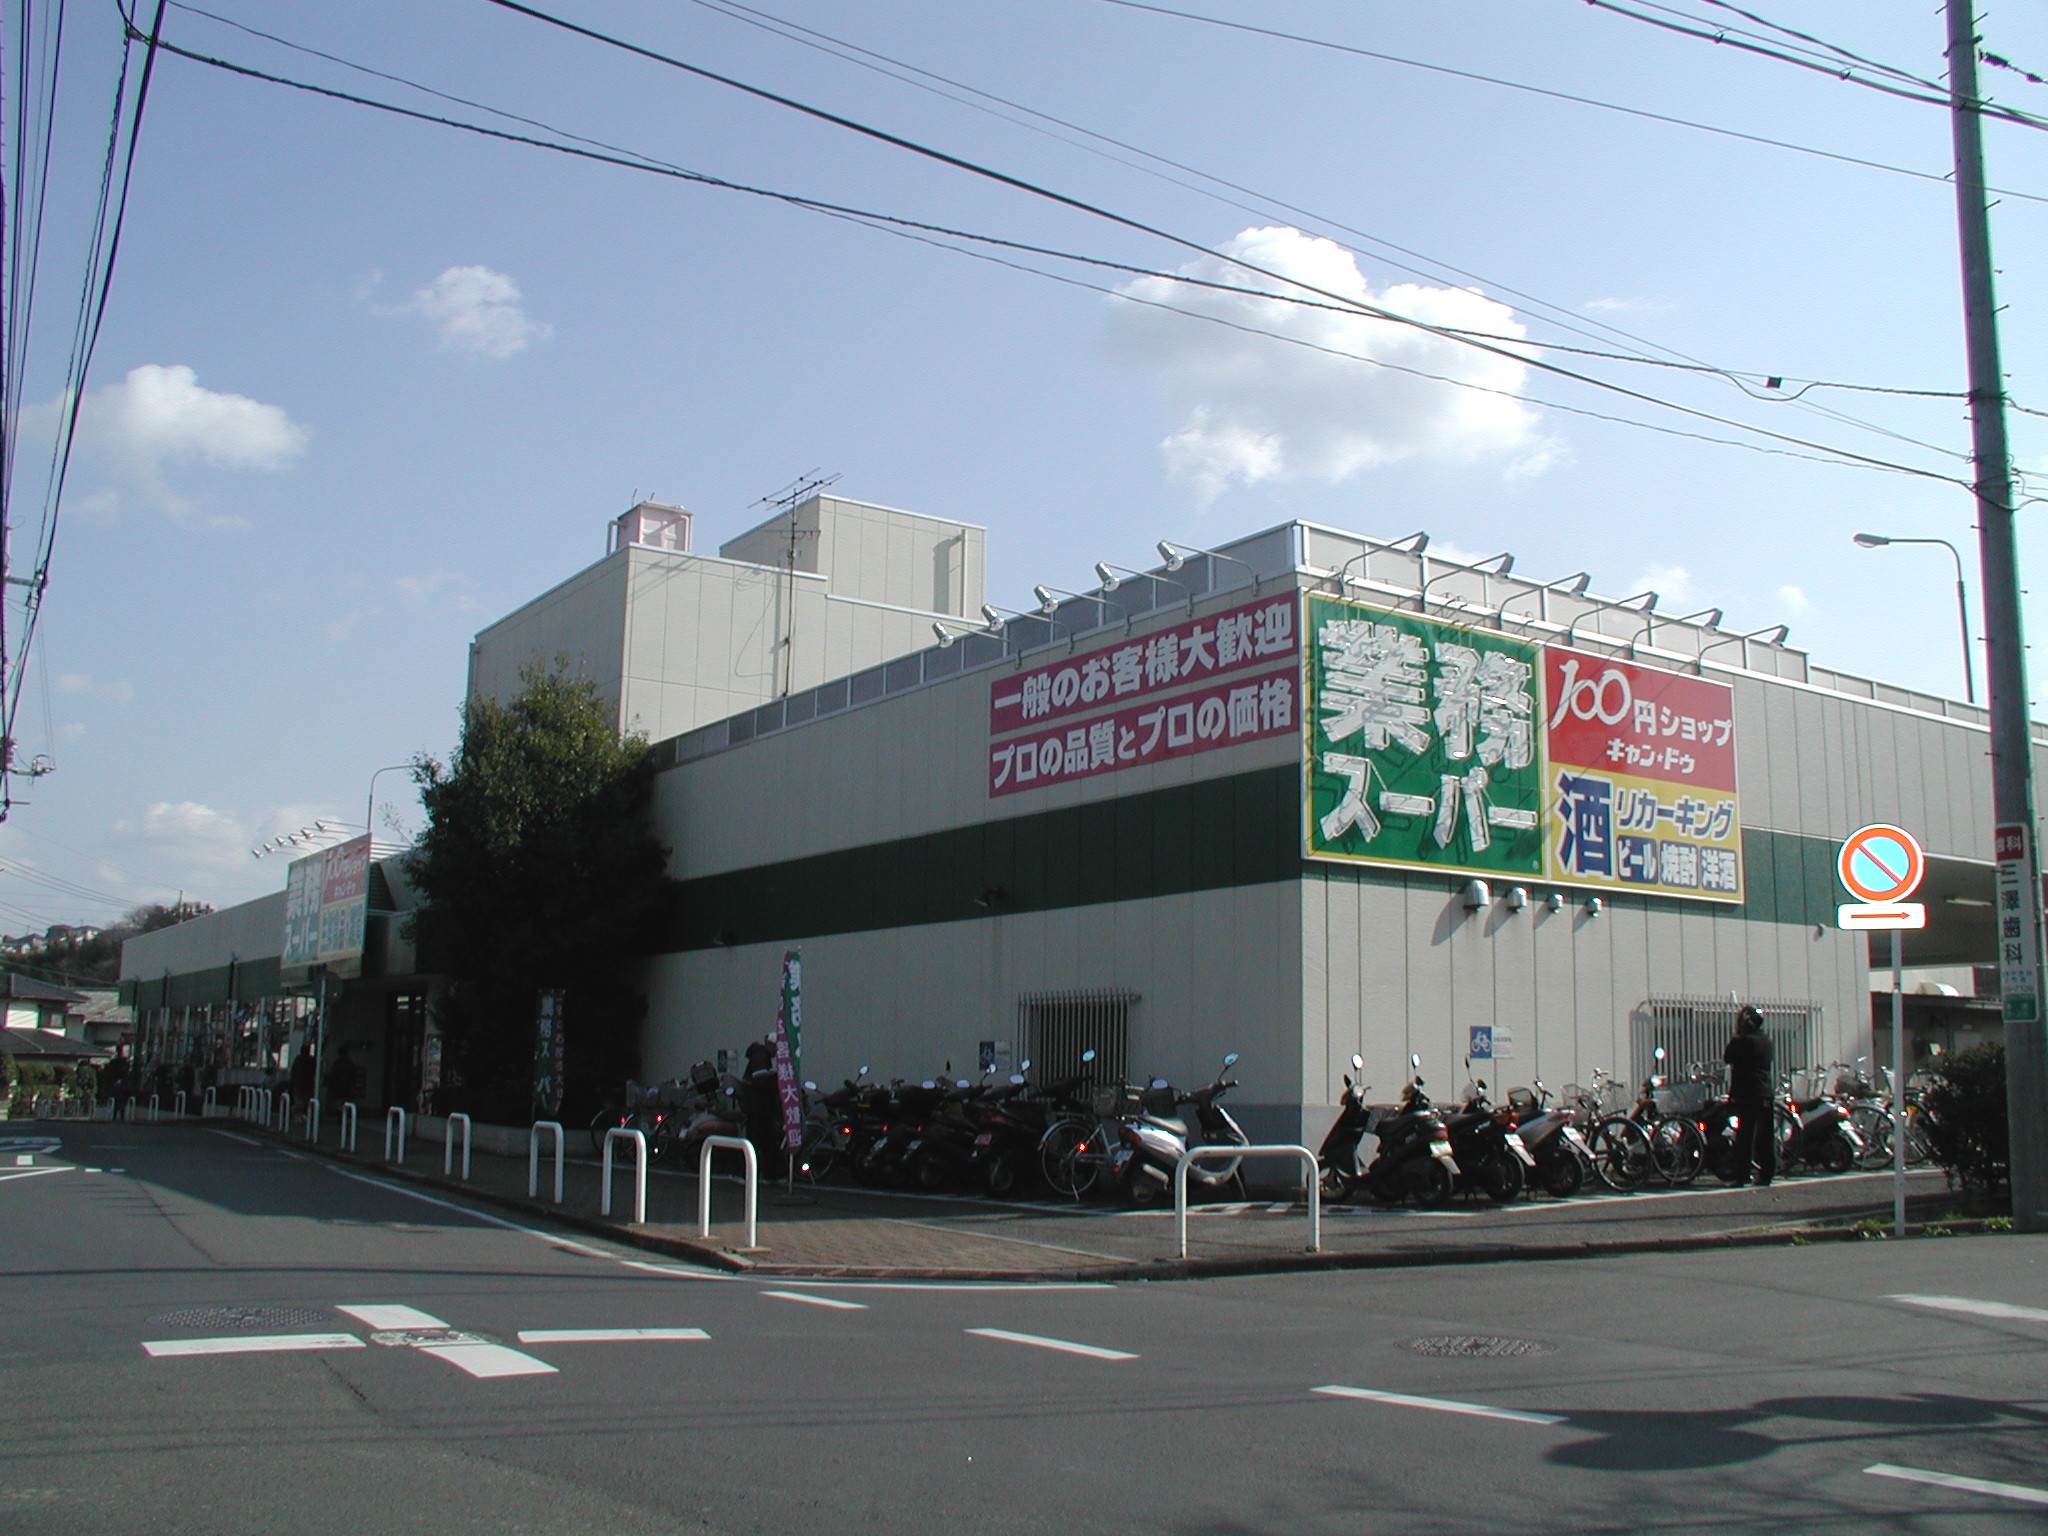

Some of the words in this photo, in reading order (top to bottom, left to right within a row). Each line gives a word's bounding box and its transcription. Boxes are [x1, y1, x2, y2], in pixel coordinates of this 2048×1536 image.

[994, 603, 1293, 719] 一般のお客様大歓迎
[1318, 618, 1534, 769] 業務
[992, 678, 1292, 789] プロの品質とプロの価格
[1319, 751, 1538, 853] スーパー
[1554, 768, 1616, 881] 酒
[1615, 787, 1735, 842] リカーキング
[1617, 838, 1659, 880] ビール
[1661, 842, 1698, 887] 焼酎
[1701, 848, 1737, 891] 洋酒
